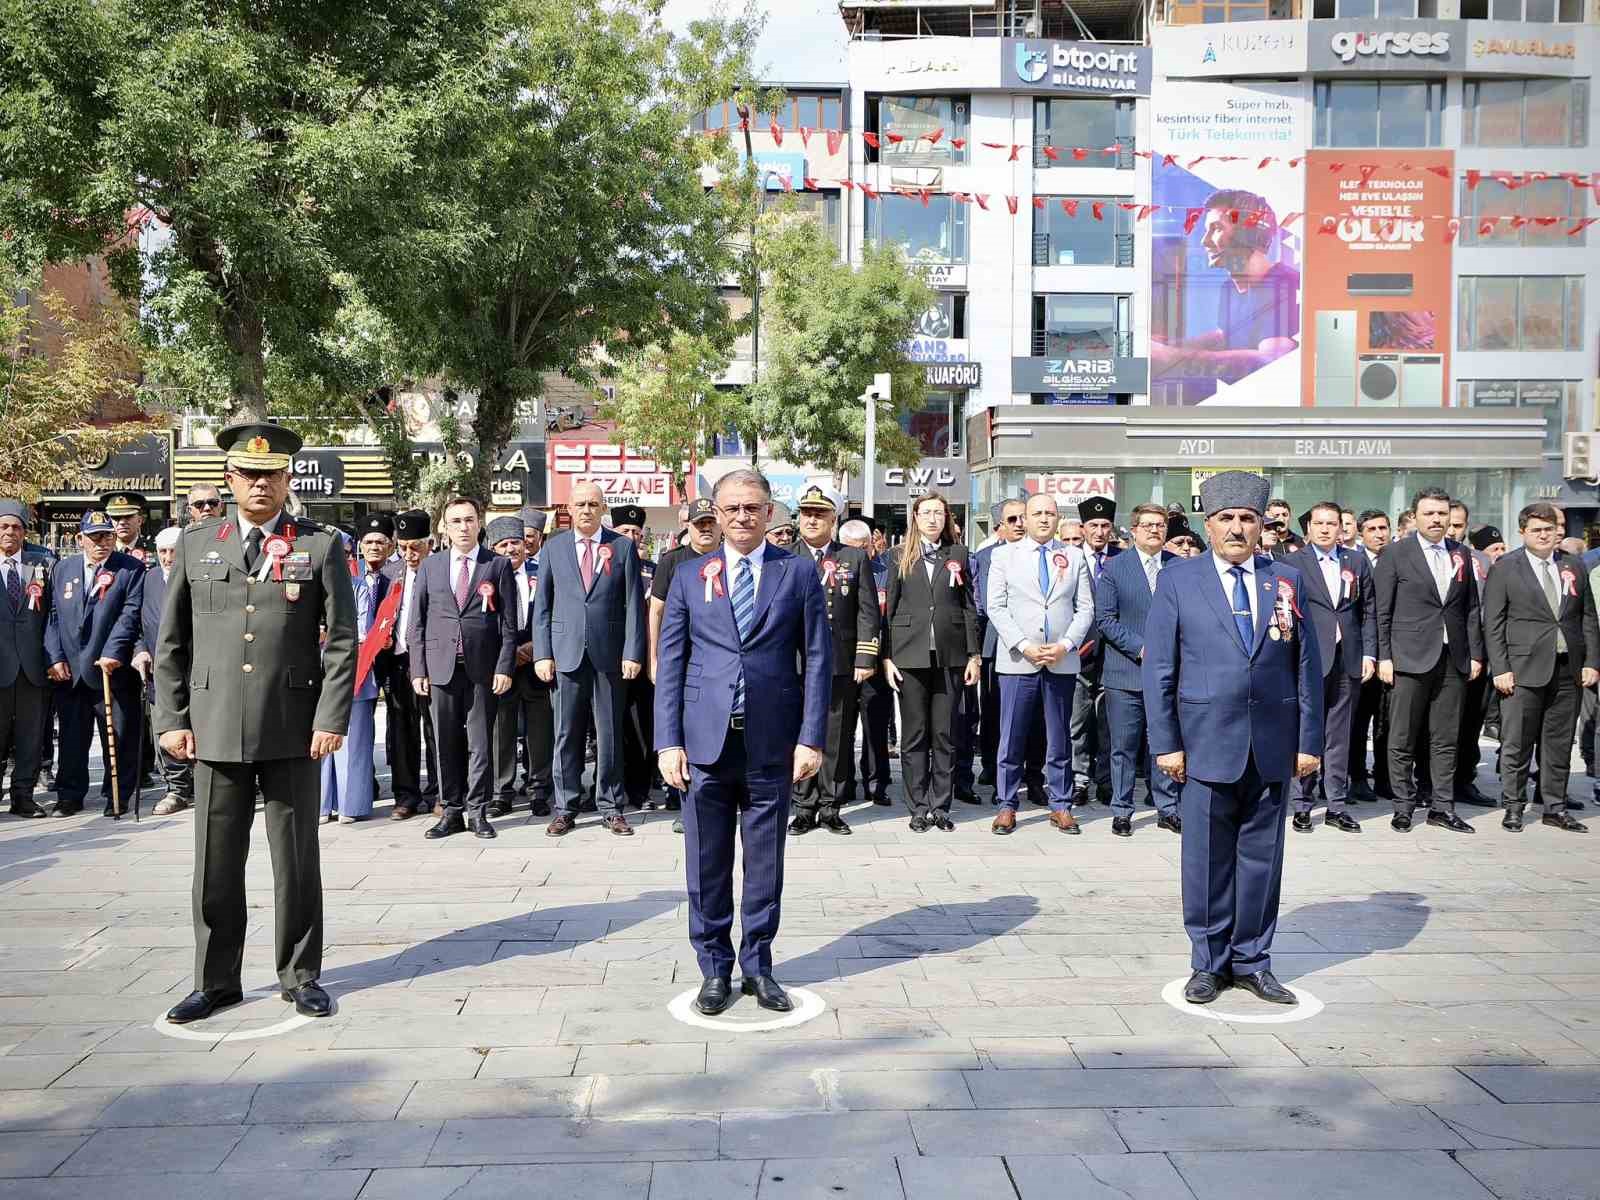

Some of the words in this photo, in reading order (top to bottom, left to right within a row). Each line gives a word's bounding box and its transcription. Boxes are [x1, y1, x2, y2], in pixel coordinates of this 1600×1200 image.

[1053, 44, 1138, 72] btpoint
[1332, 32, 1449, 62] gürses
[1214, 112, 1242, 124] fiber
[1246, 113, 1293, 124] internet
[1337, 217, 1425, 243] OLUR
[1295, 440, 1315, 455] ER
[1356, 440, 1392, 455] AVM
